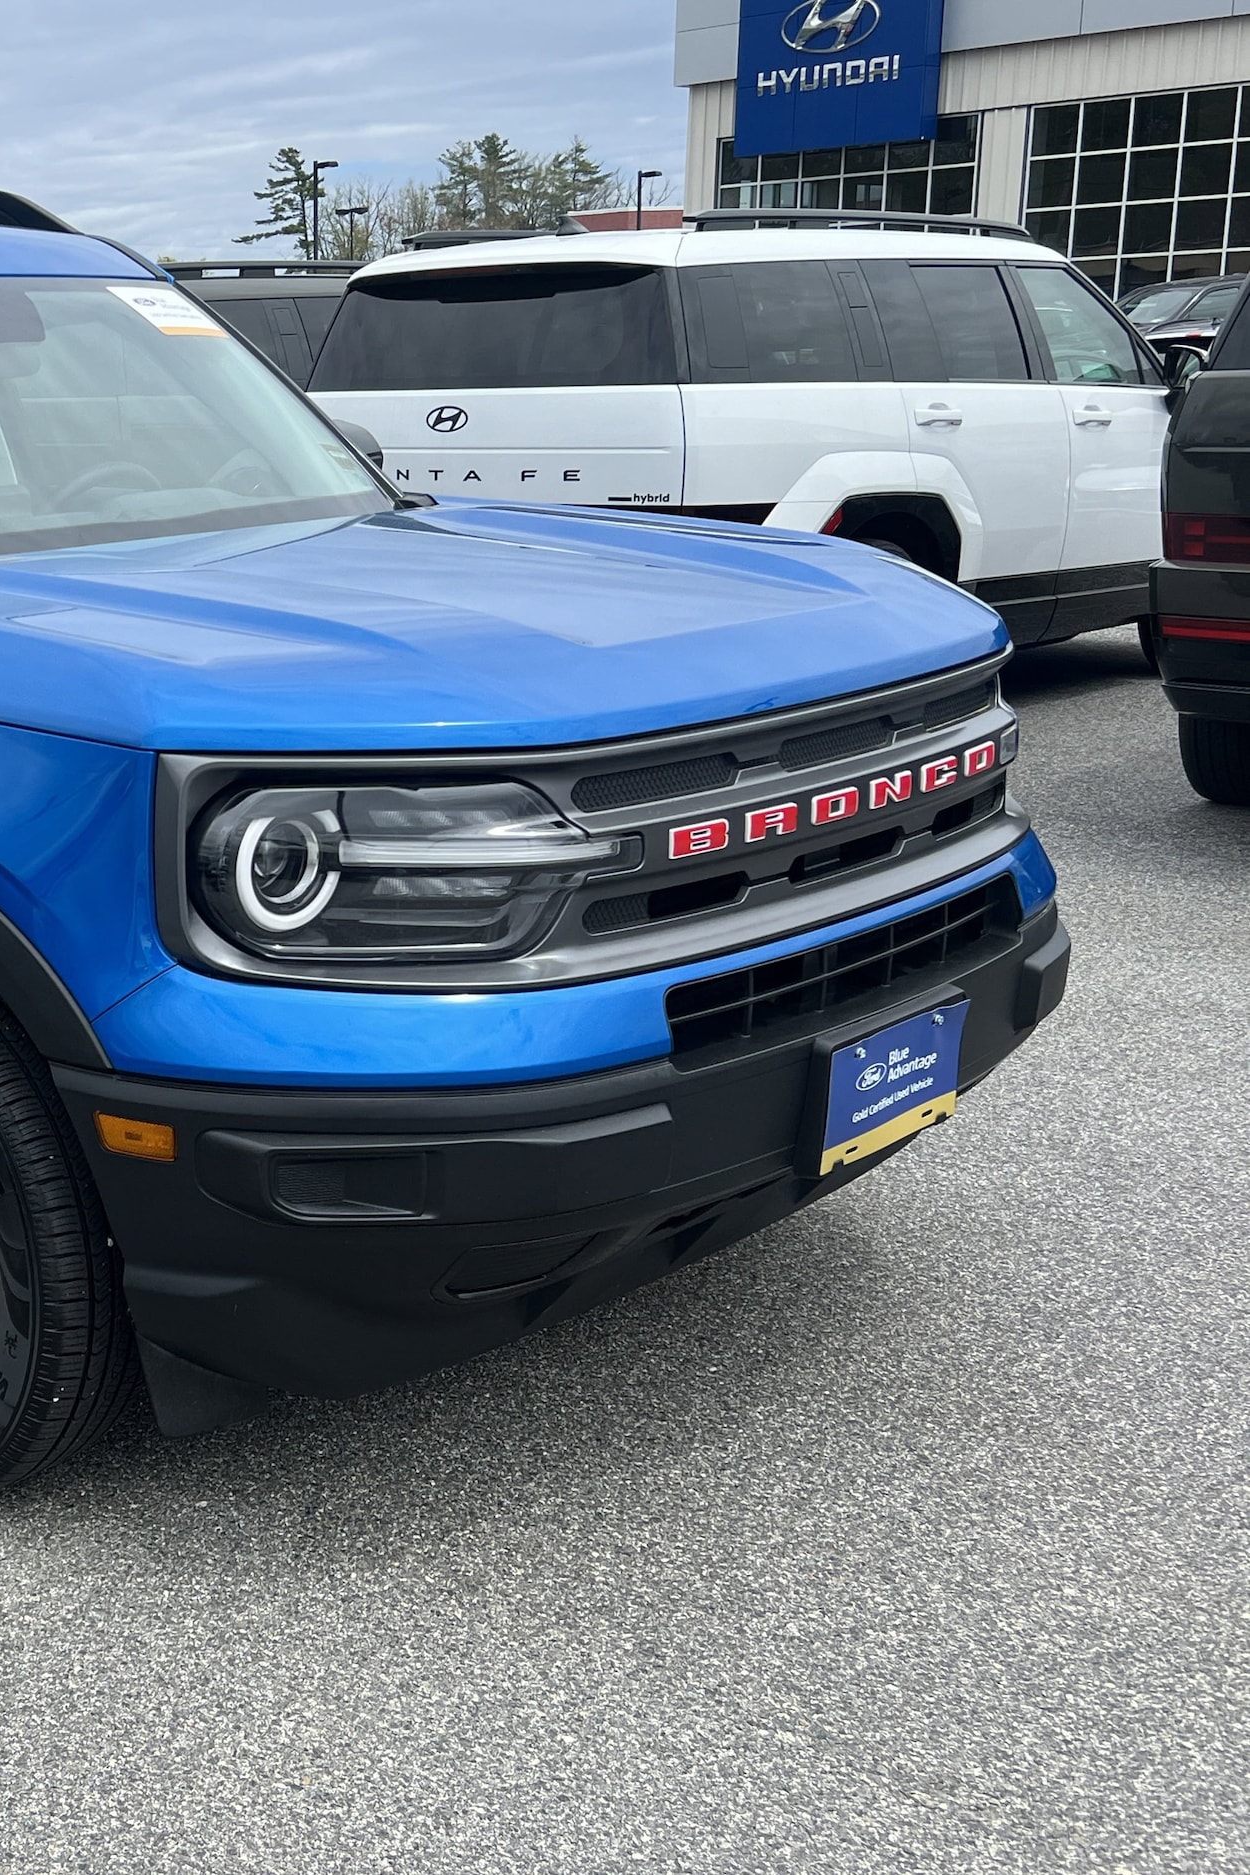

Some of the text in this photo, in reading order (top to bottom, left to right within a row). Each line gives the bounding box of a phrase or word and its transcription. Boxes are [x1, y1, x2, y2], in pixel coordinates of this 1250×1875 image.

[756, 54, 901, 98] HYUNDAI
[395, 469, 581, 482] NTA FE
[633, 493, 671, 504] hybrid
[668, 740, 996, 860] BRONCO
[860, 1052, 938, 1088] Ford Advantage
[888, 1046, 910, 1066] Blue
[851, 1076, 934, 1123] Gold Certified Used Vehicle
